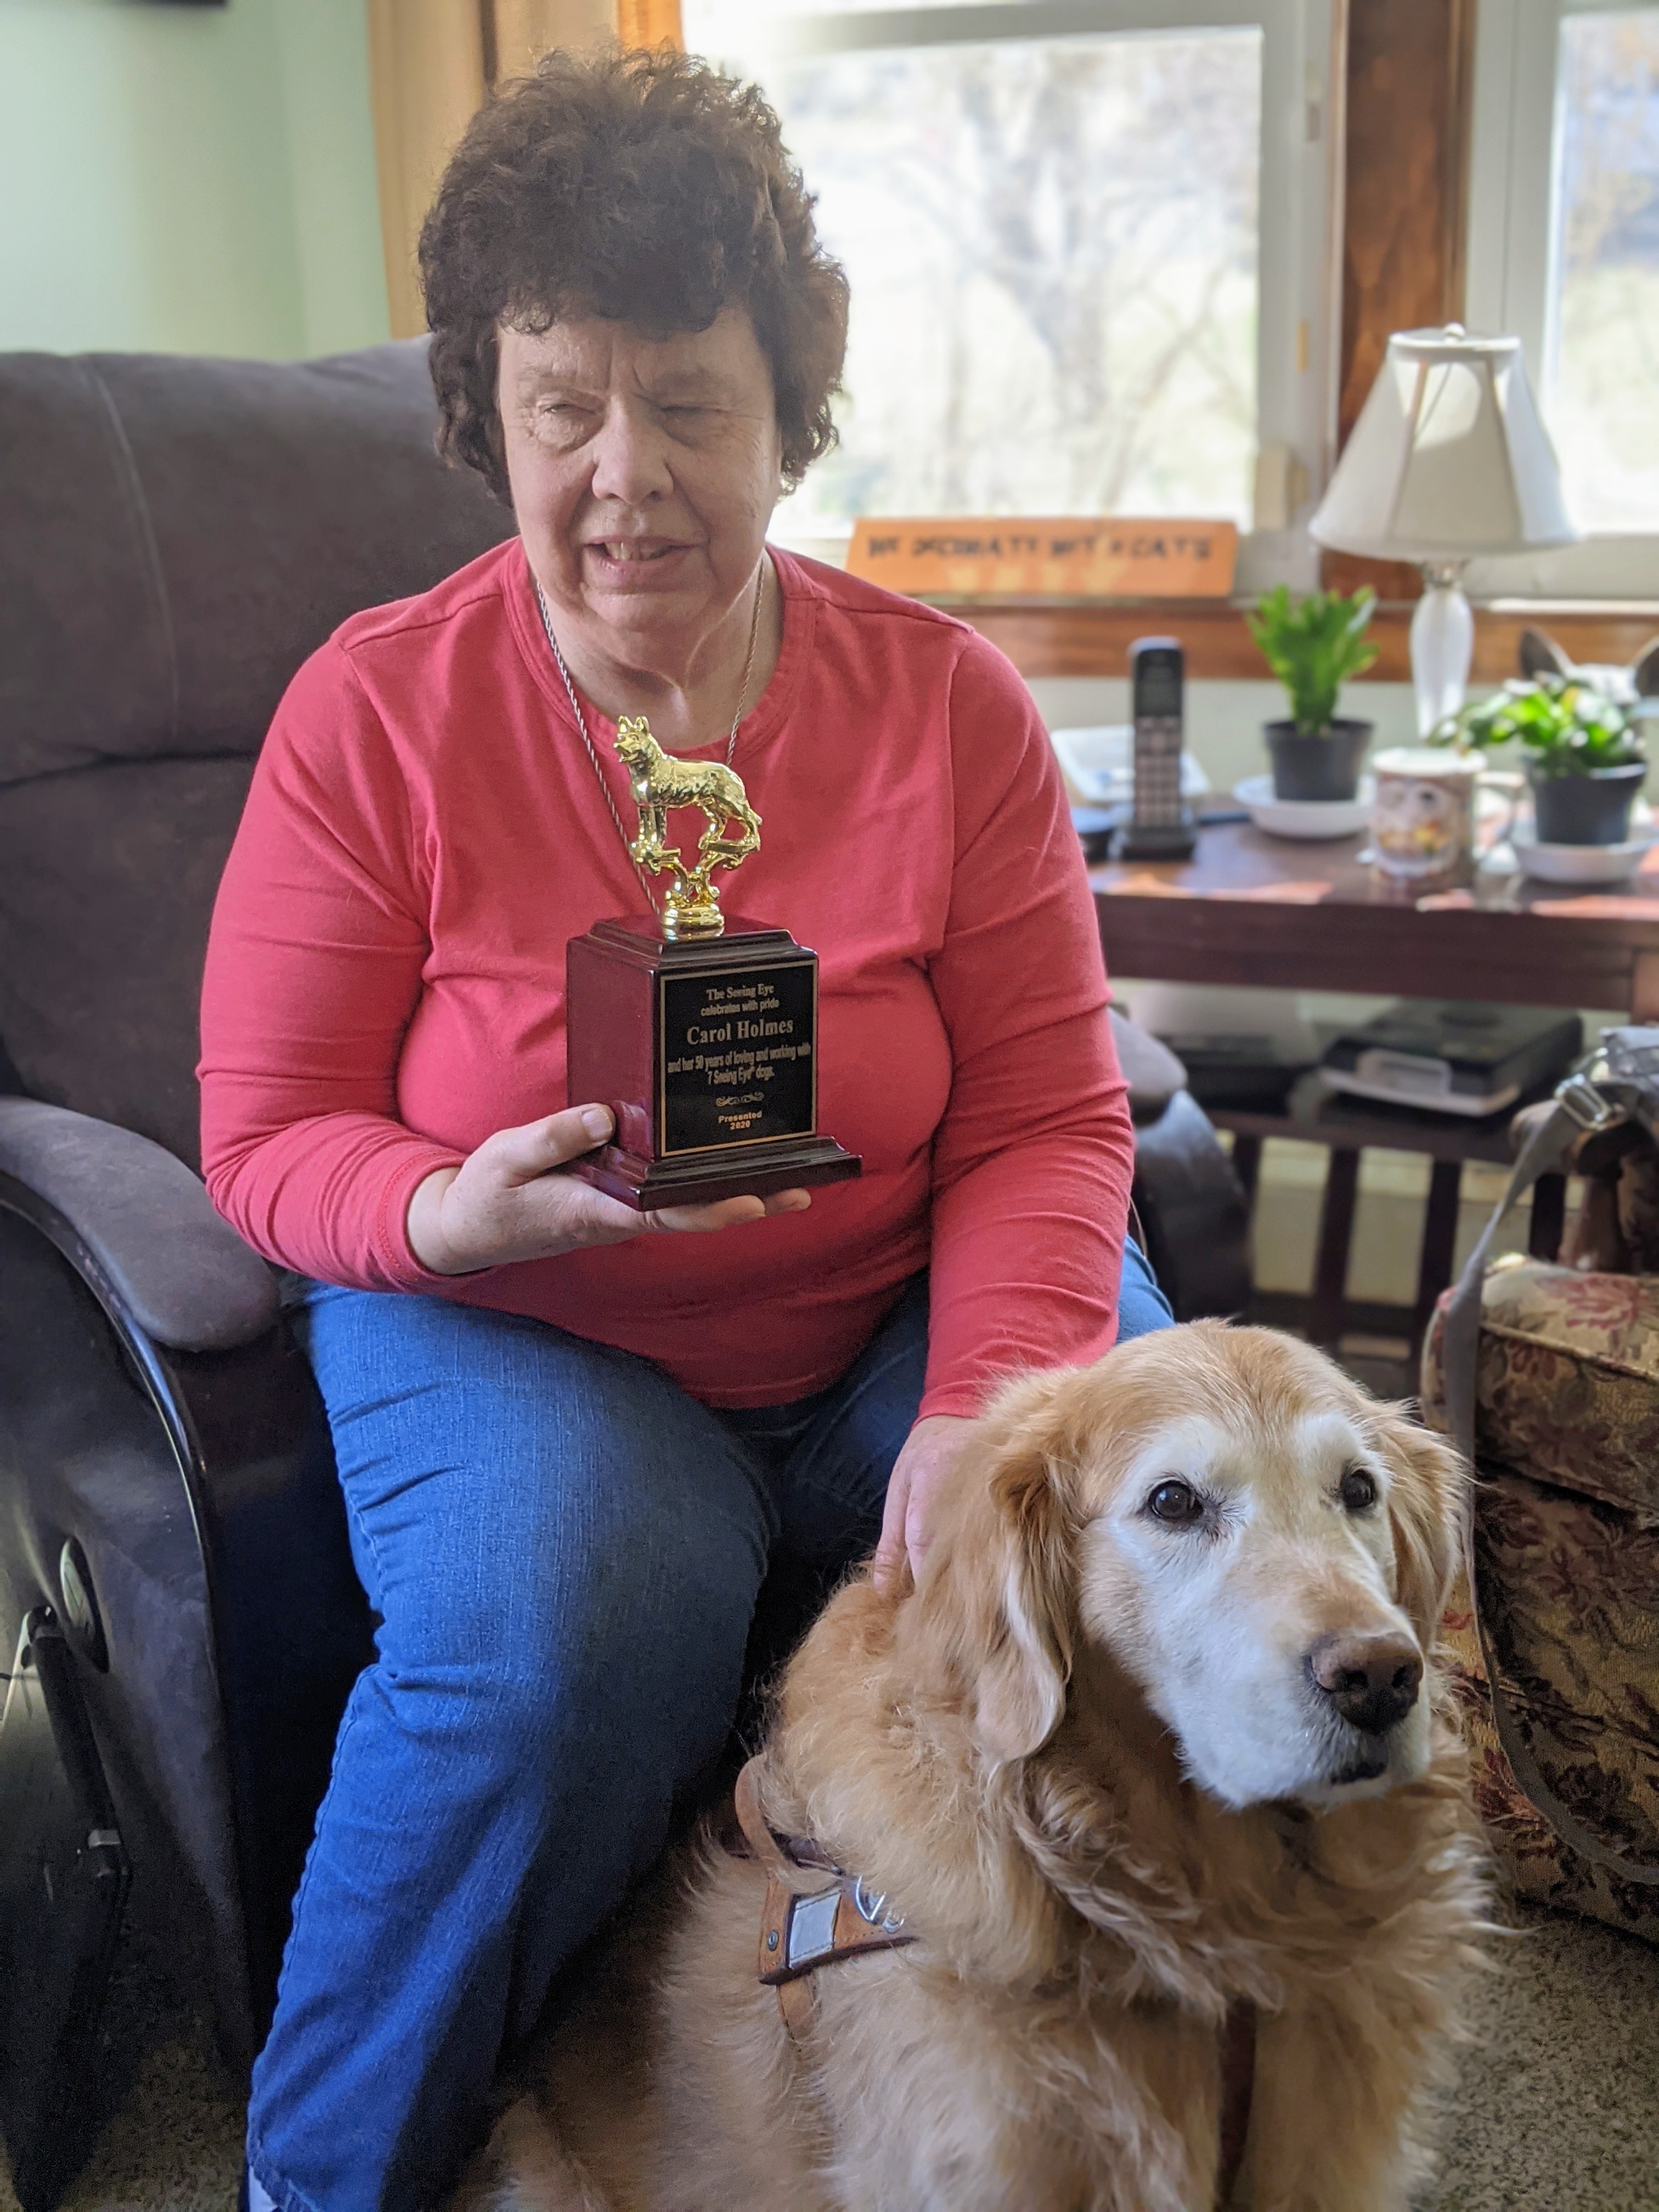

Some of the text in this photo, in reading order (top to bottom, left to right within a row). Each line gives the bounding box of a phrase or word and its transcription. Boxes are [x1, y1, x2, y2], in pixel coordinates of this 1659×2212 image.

[706, 984, 774, 1001] The Seeing Eye
[701, 997, 779, 1017] celebrates with pride
[687, 1019, 793, 1045] Carol Holmes
[668, 1057, 681, 1073] and
[695, 1055, 704, 1069] 50
[704, 1055, 724, 1072] years
[725, 1051, 733, 1066] of
[733, 1049, 754, 1067] loving
[769, 1044, 796, 1061] working
[797, 1042, 811, 1056] with
[708, 1071, 713, 1085] 7
[714, 1069, 737, 1085] Seeing
[719, 1111, 762, 1124] Presented
[730, 1120, 751, 1130] 2020
